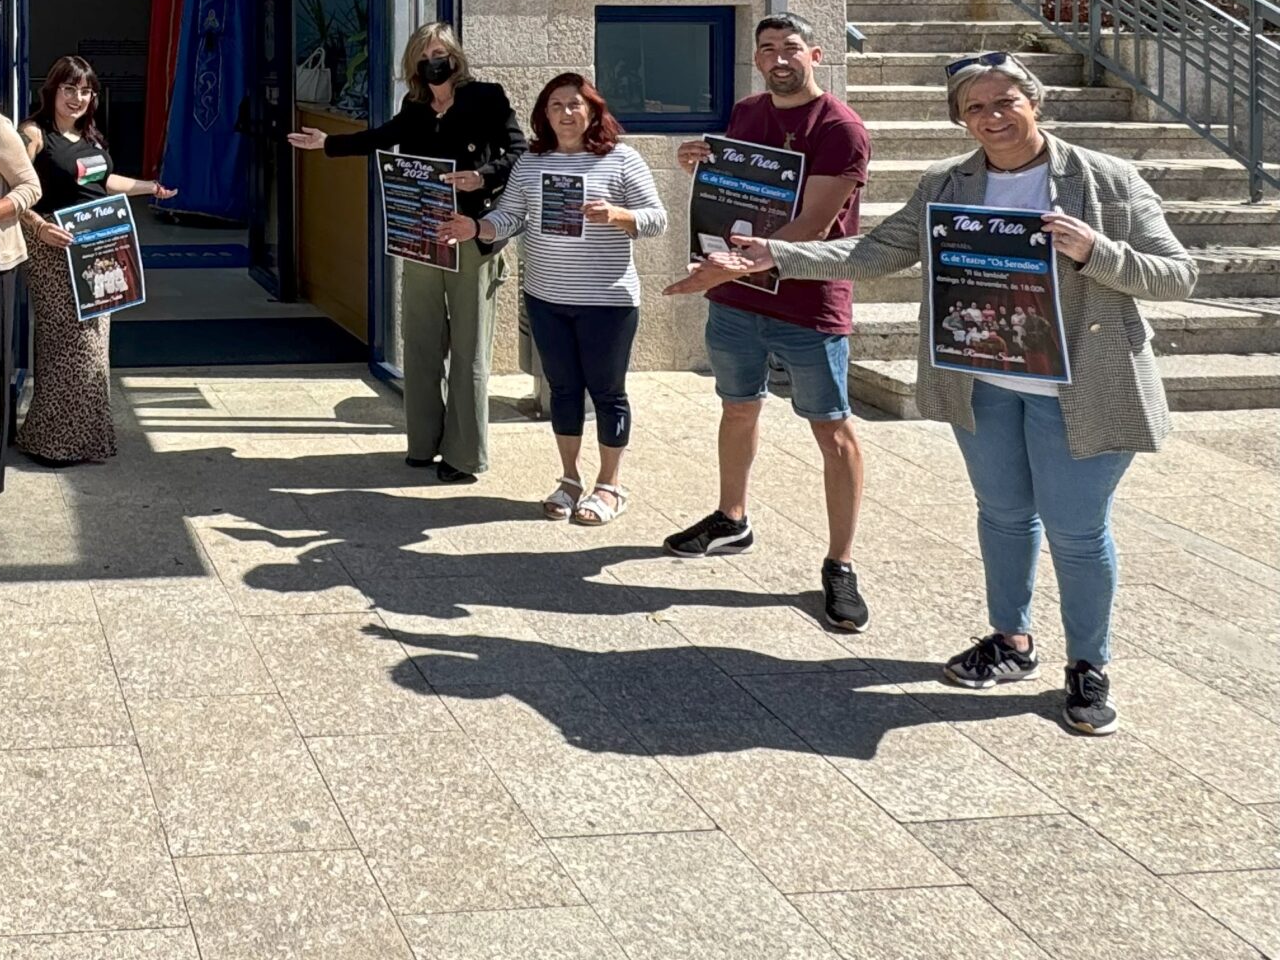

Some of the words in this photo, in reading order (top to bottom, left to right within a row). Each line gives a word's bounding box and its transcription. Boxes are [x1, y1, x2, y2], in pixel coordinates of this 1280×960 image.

[395, 158, 412, 168] Tea
[413, 161, 434, 172] Trea
[723, 148, 746, 162] Tea
[750, 153, 781, 170] Trea
[403, 169, 429, 179] 2025
[74, 211, 92, 222] Tea
[93, 206, 114, 218] Trea
[953, 215, 983, 231] Tea
[988, 218, 1027, 235] Trea
[950, 254, 959, 262] de
[960, 255, 986, 265] Teatro
